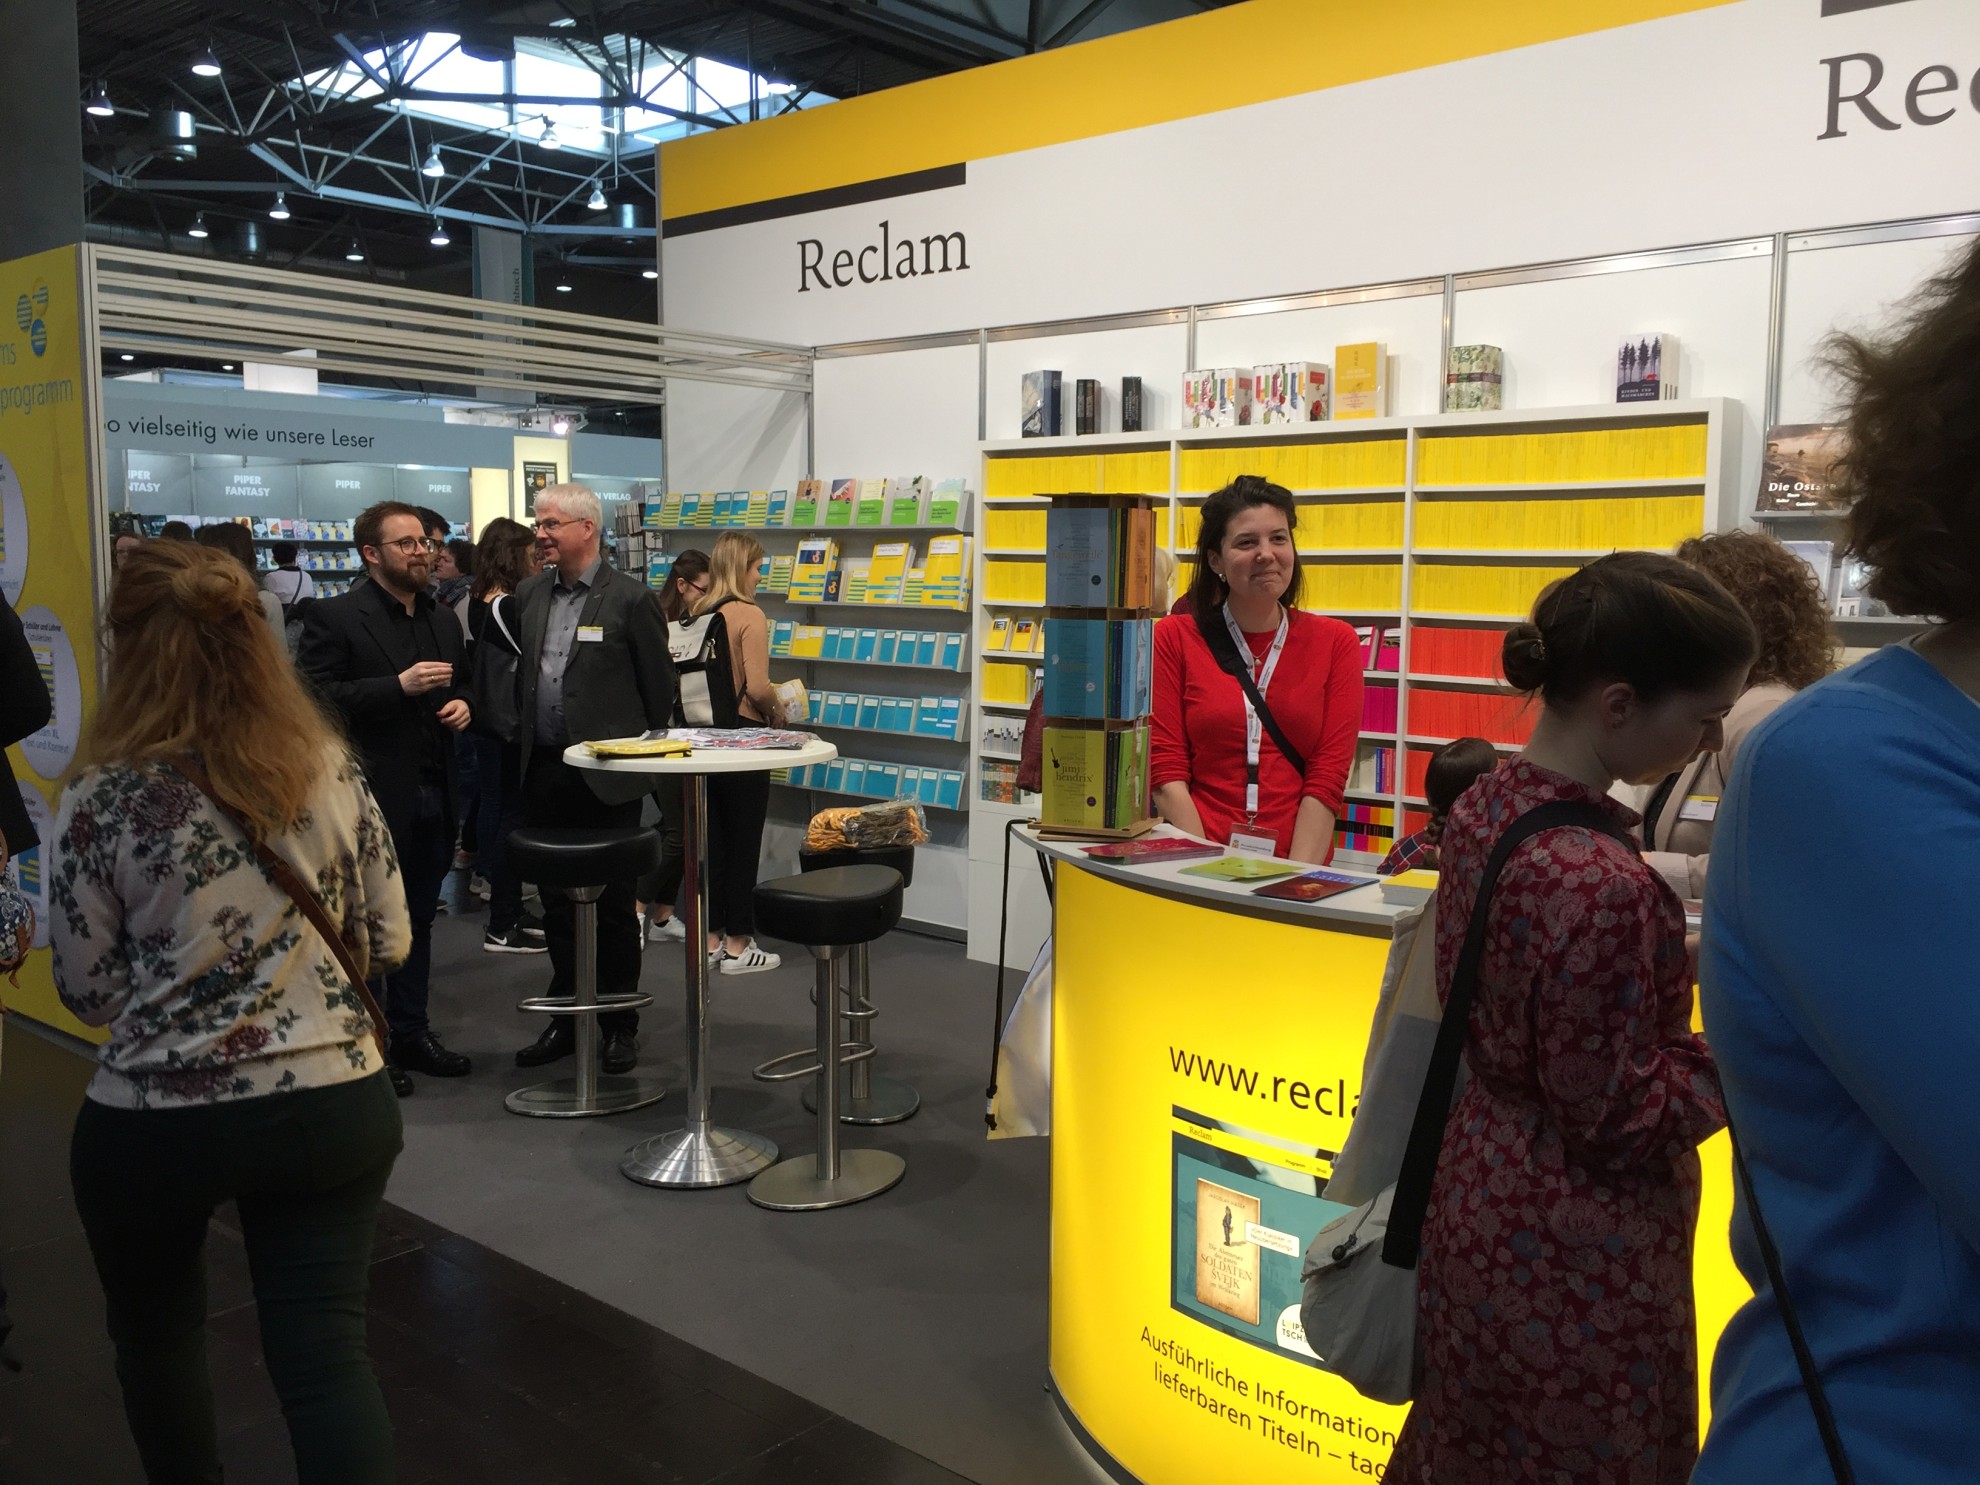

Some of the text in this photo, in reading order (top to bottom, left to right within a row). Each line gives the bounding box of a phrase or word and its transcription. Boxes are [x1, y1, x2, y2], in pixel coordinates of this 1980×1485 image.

[1817, 52, 1980, 141] Re
[797, 220, 971, 293] Reclam
[103, 415, 376, 449] o vielseitig wie unsere Leser
[128, 470, 151, 480] IPER
[233, 474, 262, 486] PIPER
[128, 482, 161, 493] NTASY
[335, 479, 361, 490] PIPER
[428, 483, 453, 493] PIPER
[1768, 482, 1790, 492] Die
[225, 486, 271, 498] FANTASY
[602, 492, 632, 501] VERLAG
[1188, 1125, 1213, 1142] Reclam
[1200, 1253, 1253, 1281] SOLDATEN
[1282, 1328, 1308, 1343] TSCH
[1141, 1325, 1249, 1397] Ausführliche
[1154, 1361, 1251, 1431] lieferbaren
[1258, 1415, 1320, 1458] Titeln
